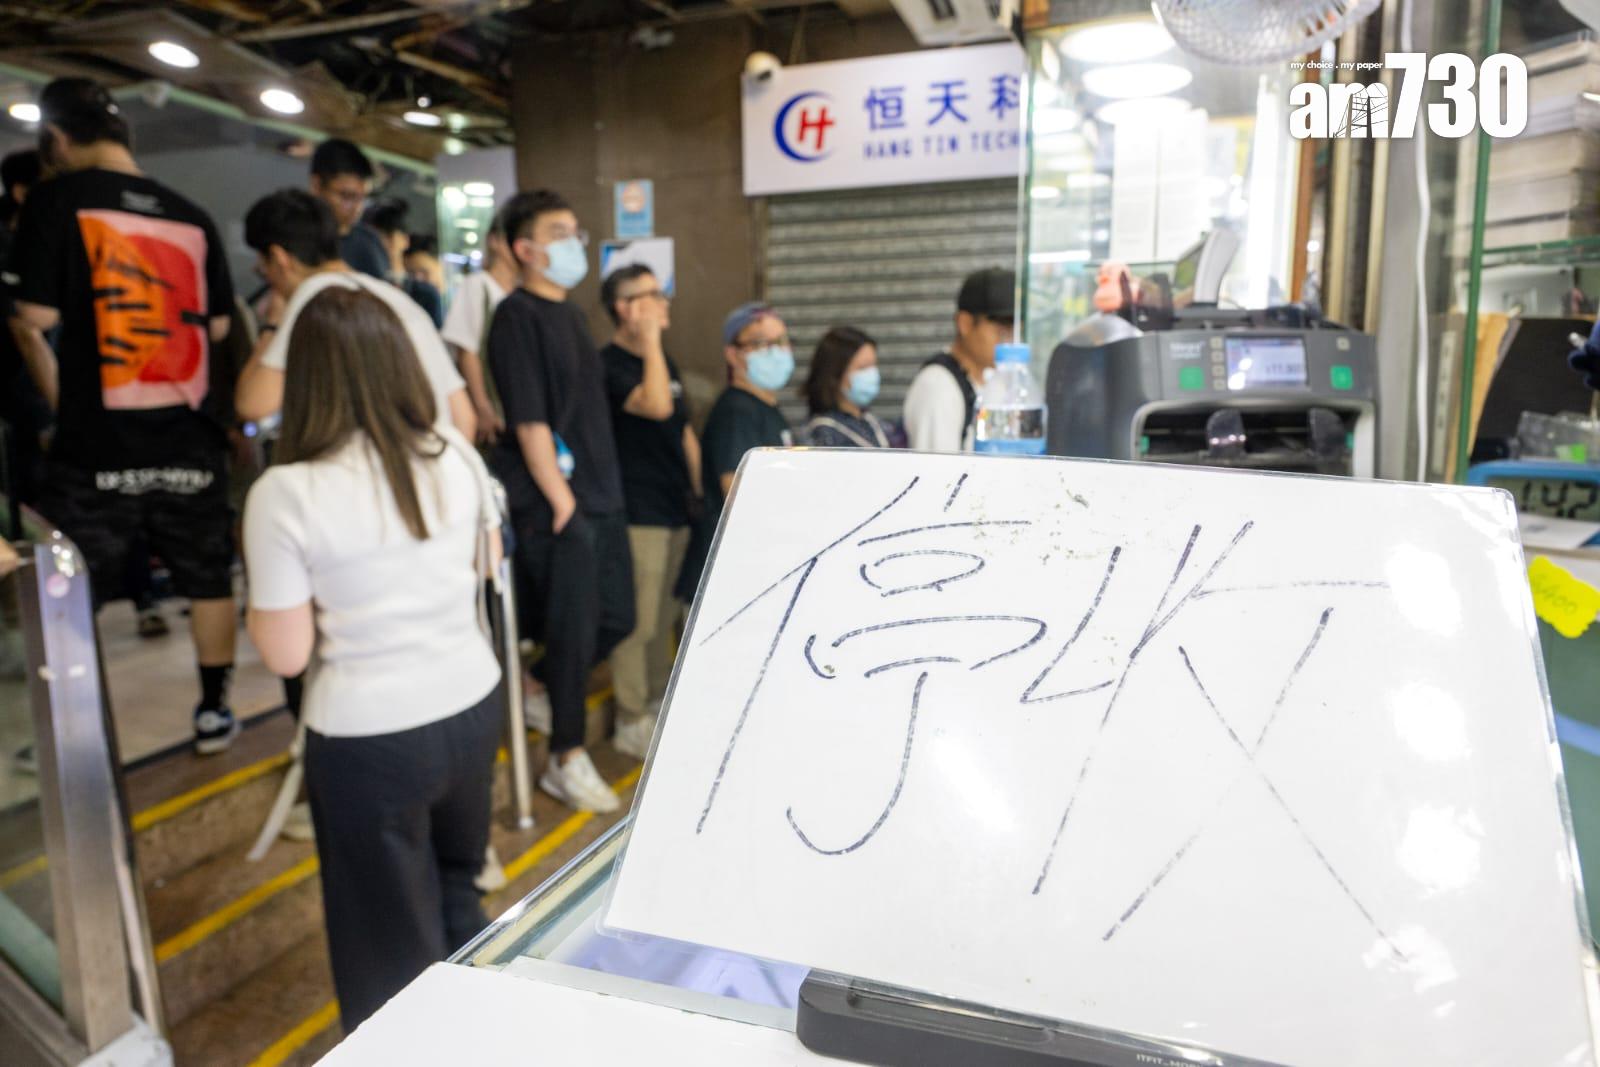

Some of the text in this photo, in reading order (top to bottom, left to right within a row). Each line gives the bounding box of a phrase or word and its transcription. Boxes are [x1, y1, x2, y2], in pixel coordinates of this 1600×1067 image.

[864, 73, 1019, 131] 恒天科
[864, 138, 912, 159] HANG
[924, 134, 959, 155] TIN
[697, 473, 1407, 961] 停收
